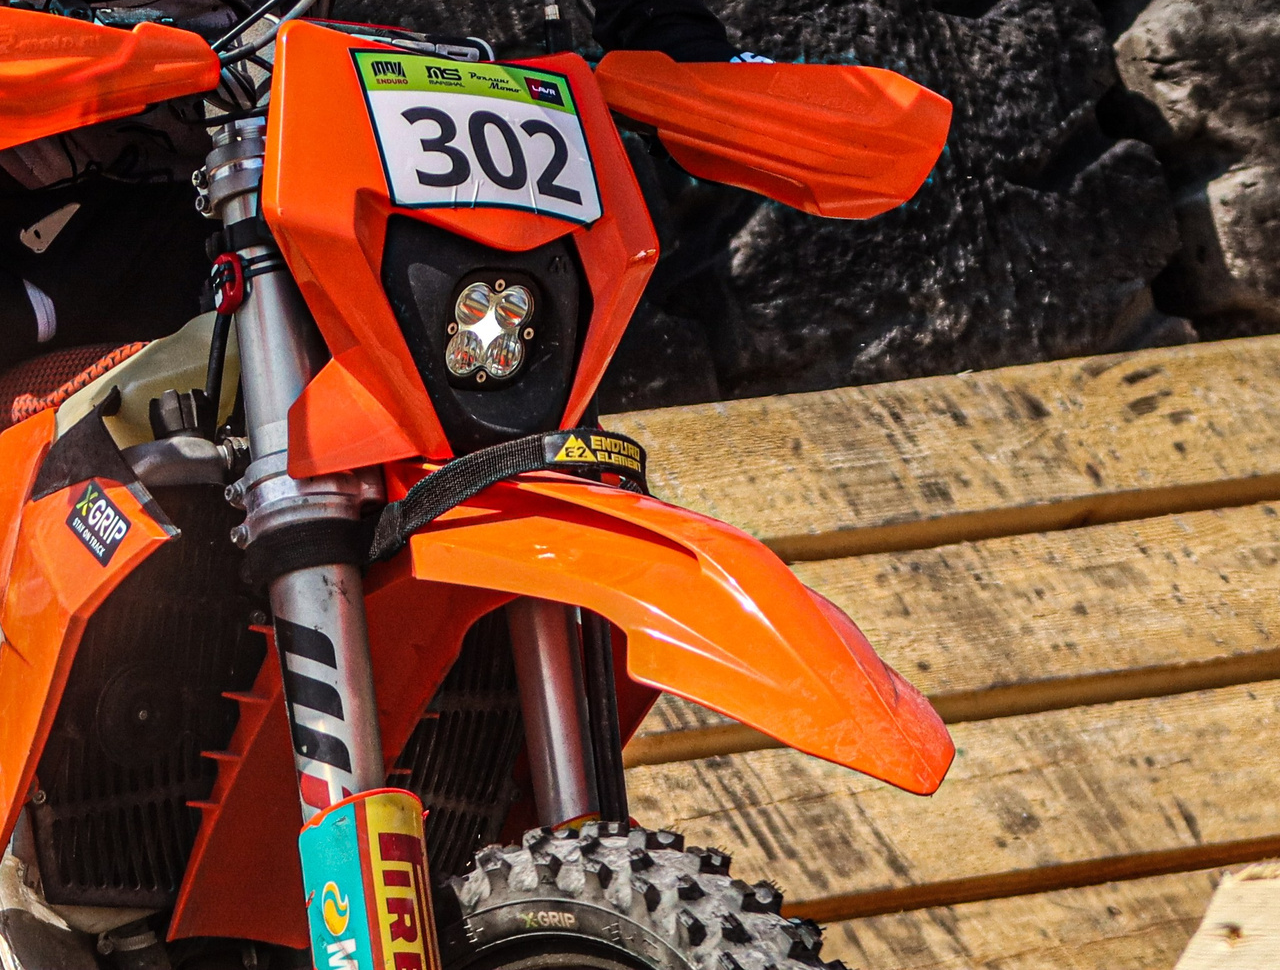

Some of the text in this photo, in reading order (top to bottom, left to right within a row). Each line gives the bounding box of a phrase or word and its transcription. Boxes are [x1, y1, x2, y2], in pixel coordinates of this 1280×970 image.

[401, 106, 583, 206] 302
[200, 287, 218, 310] 302
[564, 446, 588, 459] E2
[590, 435, 640, 461] ENDURO
[75, 484, 127, 544] X-GRIP
[72, 517, 106, 557] STAY ON TRACK
[519, 911, 576, 928] X-GRIP
